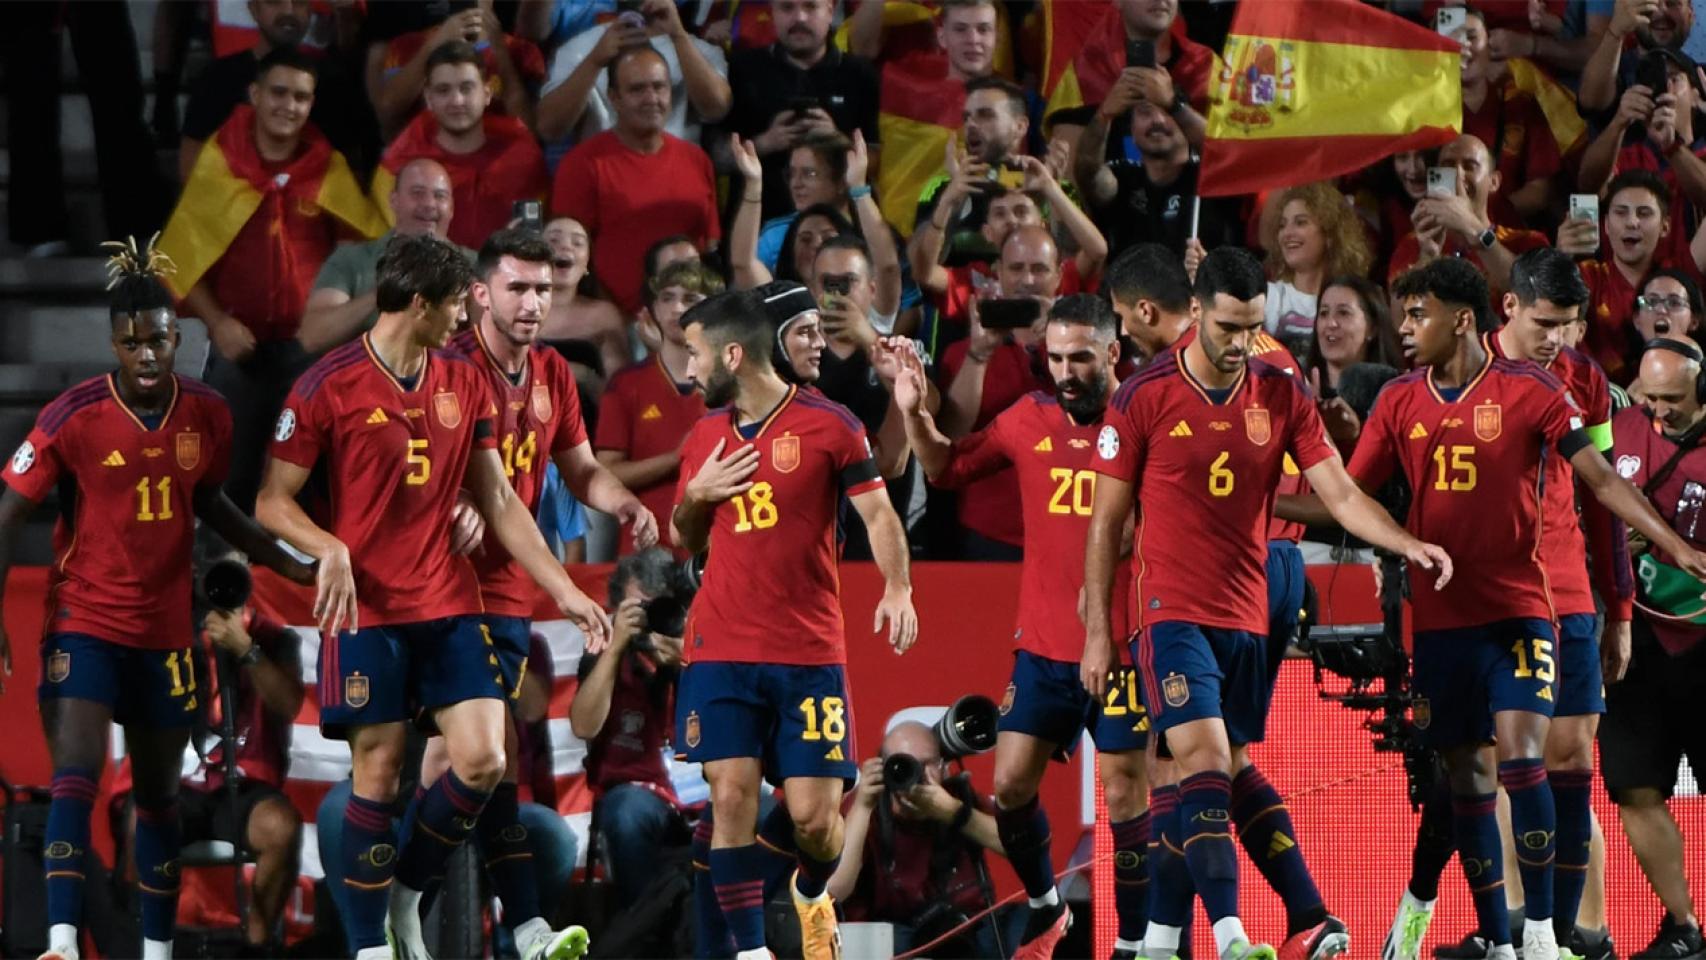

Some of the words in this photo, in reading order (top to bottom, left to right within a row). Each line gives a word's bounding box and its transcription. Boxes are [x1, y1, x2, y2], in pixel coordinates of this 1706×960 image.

[406, 439, 430, 485] 5
[502, 431, 536, 476] 14
[1208, 452, 1234, 496] 6
[1434, 446, 1476, 491] 15
[137, 477, 172, 521] 11
[731, 482, 778, 532] 18
[1048, 469, 1096, 514] 20
[165, 647, 197, 696] 11
[1512, 639, 1555, 682] 15
[799, 697, 844, 741] 18
